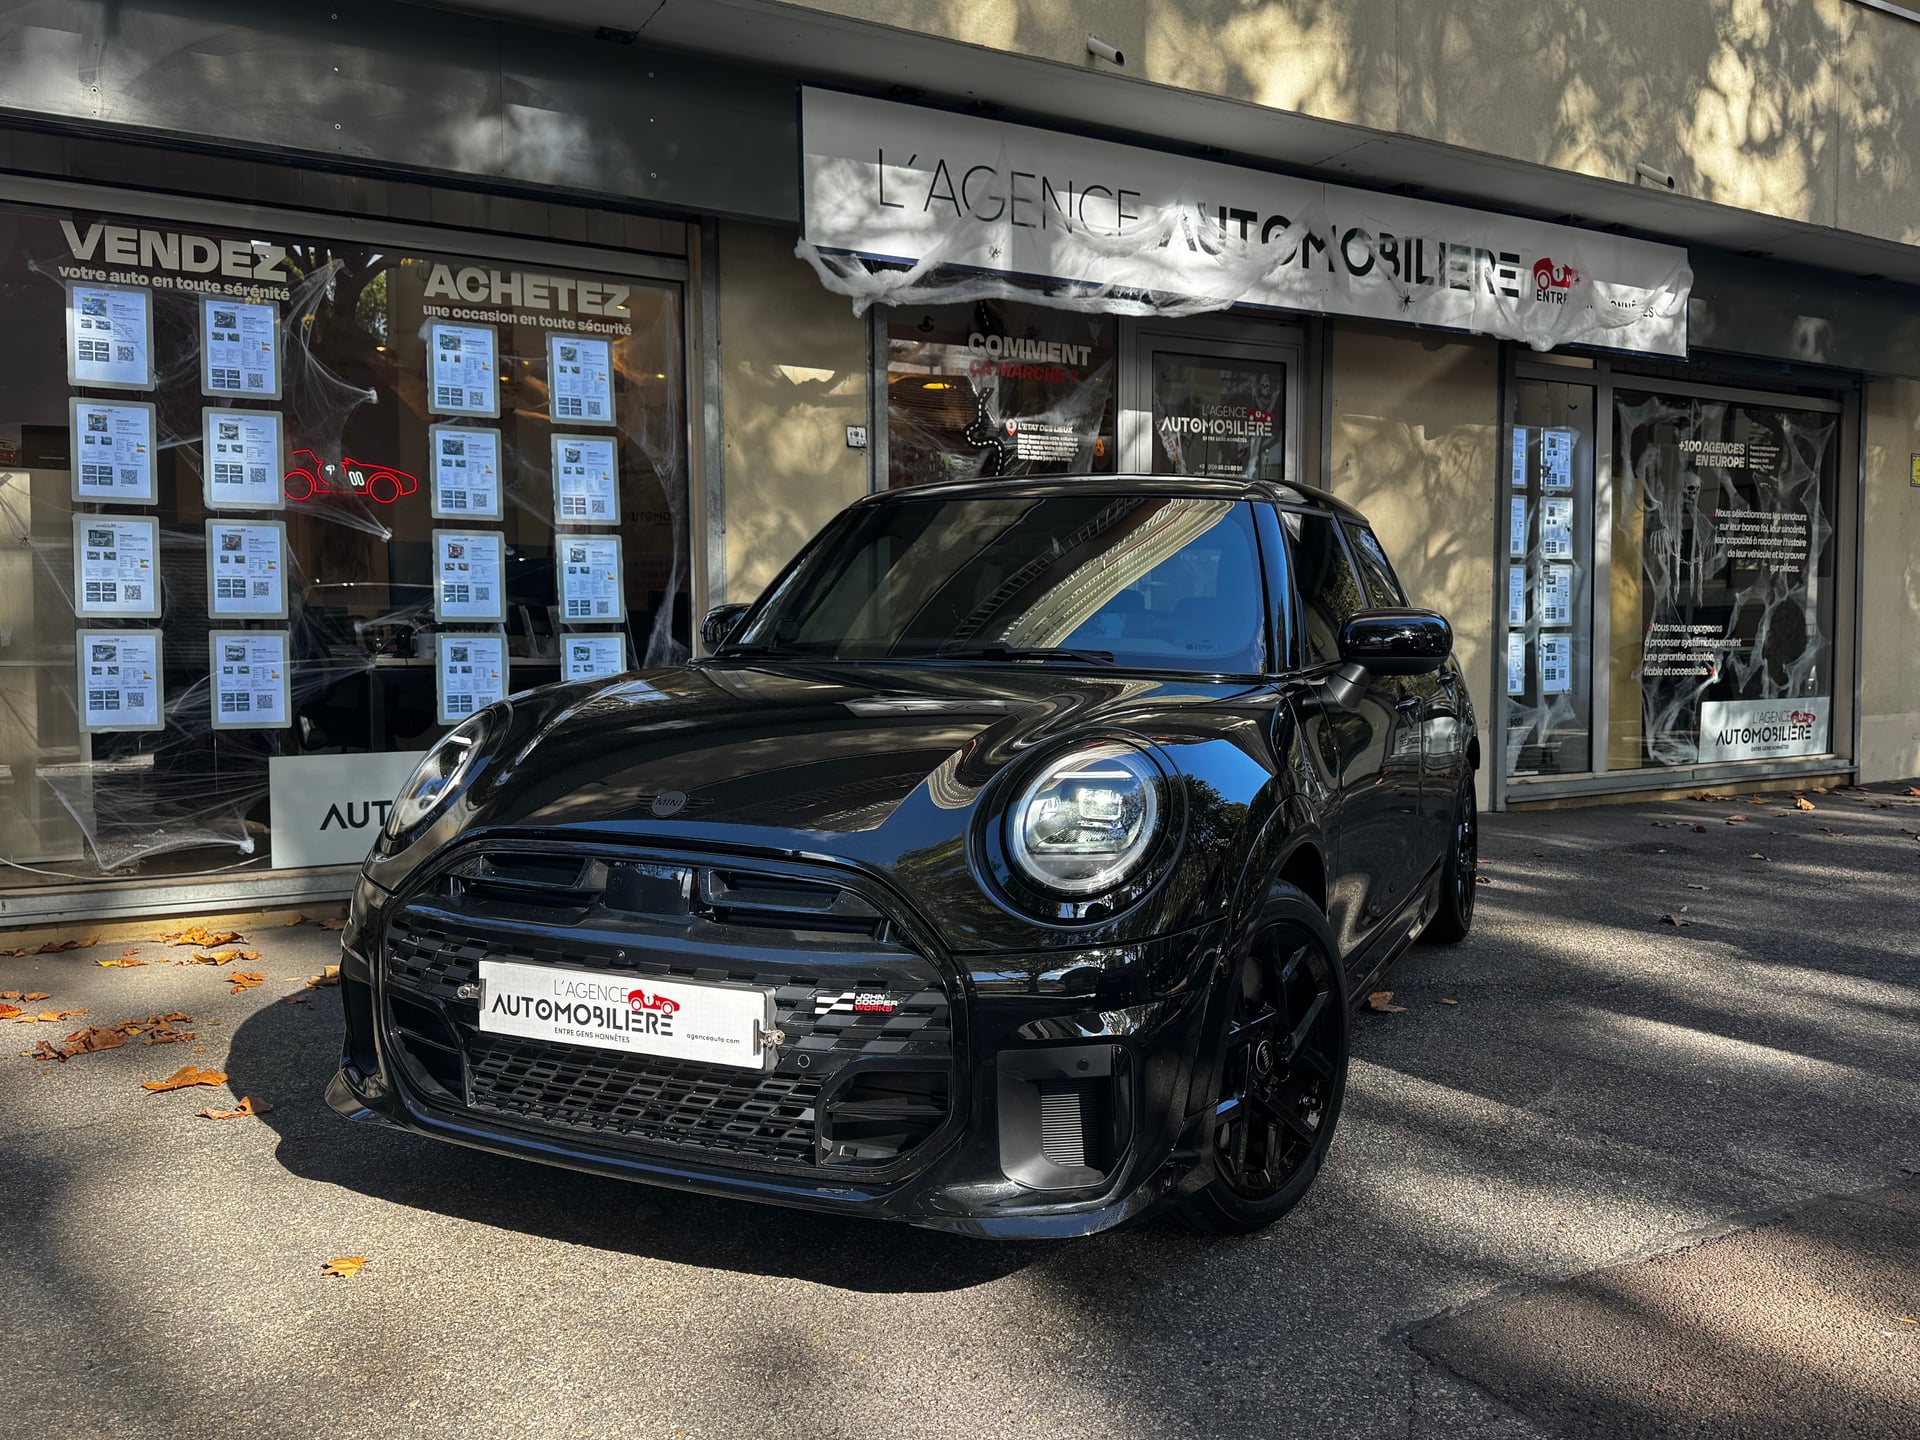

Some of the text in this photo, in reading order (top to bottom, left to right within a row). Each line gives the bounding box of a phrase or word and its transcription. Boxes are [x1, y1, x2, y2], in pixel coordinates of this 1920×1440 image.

[59, 219, 287, 283] VENDEZ
[58, 266, 290, 301] votre auto en toute sérénité
[423, 263, 631, 318] ACHETEZ
[423, 304, 632, 335] une occasion en toute sécurité
[968, 332, 1091, 366] COMMENT
[969, 359, 993, 378] ÇA
[996, 362, 1067, 384] MARCHE
[1202, 405, 1248, 418] L'AGENCE
[1679, 440, 1745, 455] +100 AGENCES
[1695, 454, 1745, 468] EN EUROPE
[1715, 509, 1731, 518] Nous
[1732, 509, 1772, 519] sélectionnons
[1781, 512, 1807, 521] vendeurs
[1720, 523, 1729, 531] sur
[1730, 522, 1741, 531] leur
[1741, 523, 1760, 532] bonne
[1770, 524, 1781, 532] leur
[1715, 535, 1726, 544] leur
[1726, 536, 1752, 546] capacité
[1758, 537, 1782, 546] raconter
[1728, 549, 1735, 558] de
[1736, 549, 1747, 558] leur
[1747, 549, 1771, 559] véhicule
[1783, 552, 1806, 560] prouver
[1770, 565, 1779, 573] sur
[1651, 622, 1723, 635] Nous nous engageons
[1650, 639, 1681, 648] proposer
[1681, 637, 1742, 649] systématiquement
[1644, 653, 1657, 662] une
[1657, 652, 1687, 663] garantie
[1644, 666, 1709, 676] fiable et accessible.
[1752, 710, 1792, 724] L'AGENCE
[554, 979, 629, 1004] L'AGENCE
[555, 1027, 740, 1044] ENTRE GENS HONNÊTES agenceauto.com
